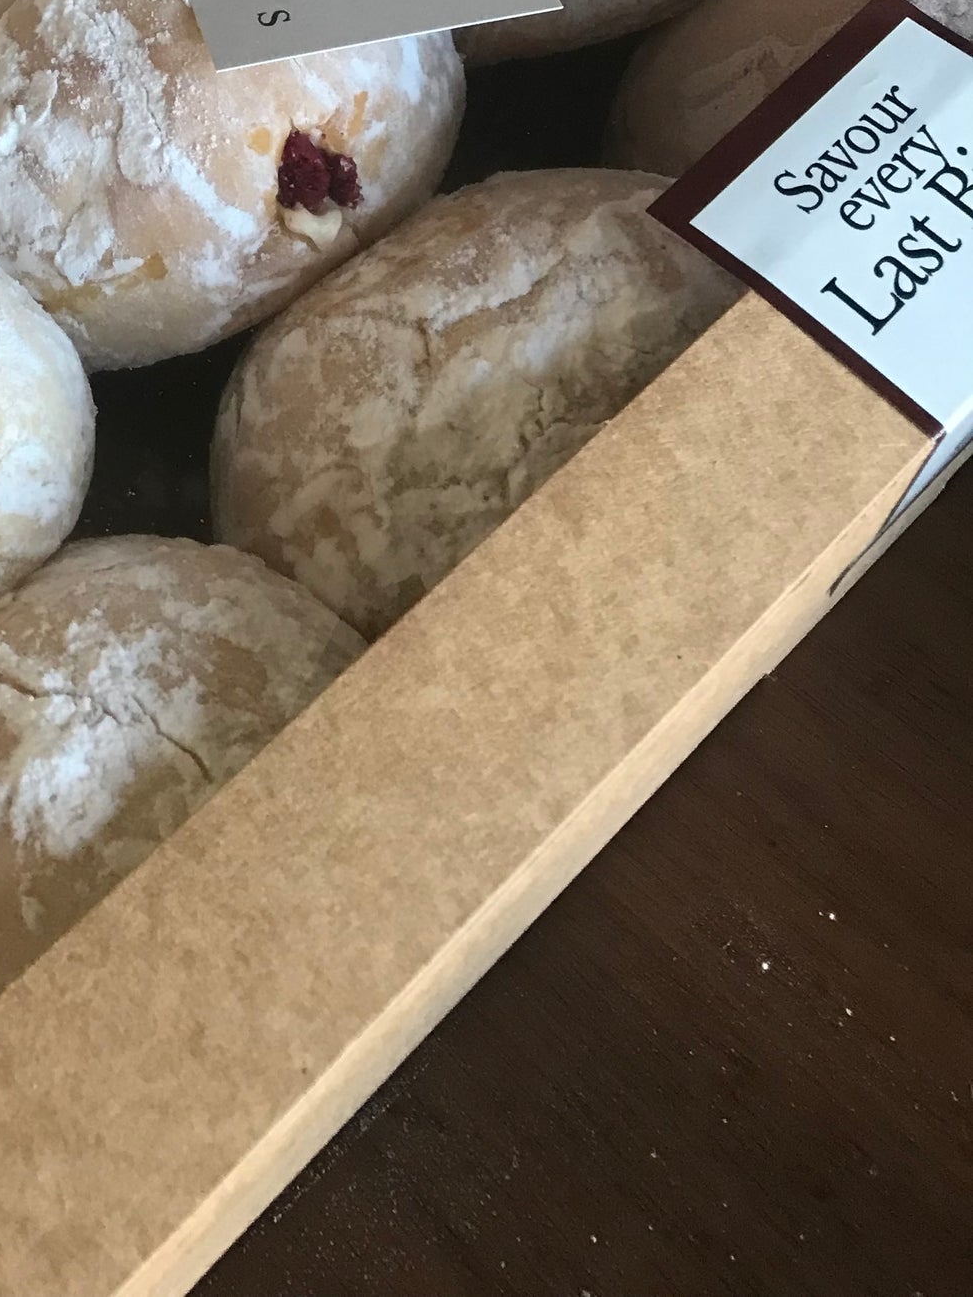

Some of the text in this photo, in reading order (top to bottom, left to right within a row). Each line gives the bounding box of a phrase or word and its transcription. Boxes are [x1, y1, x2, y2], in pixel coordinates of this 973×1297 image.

[774, 85, 917, 214] Savour
[839, 124, 951, 231] every
[820, 215, 963, 336] Last
